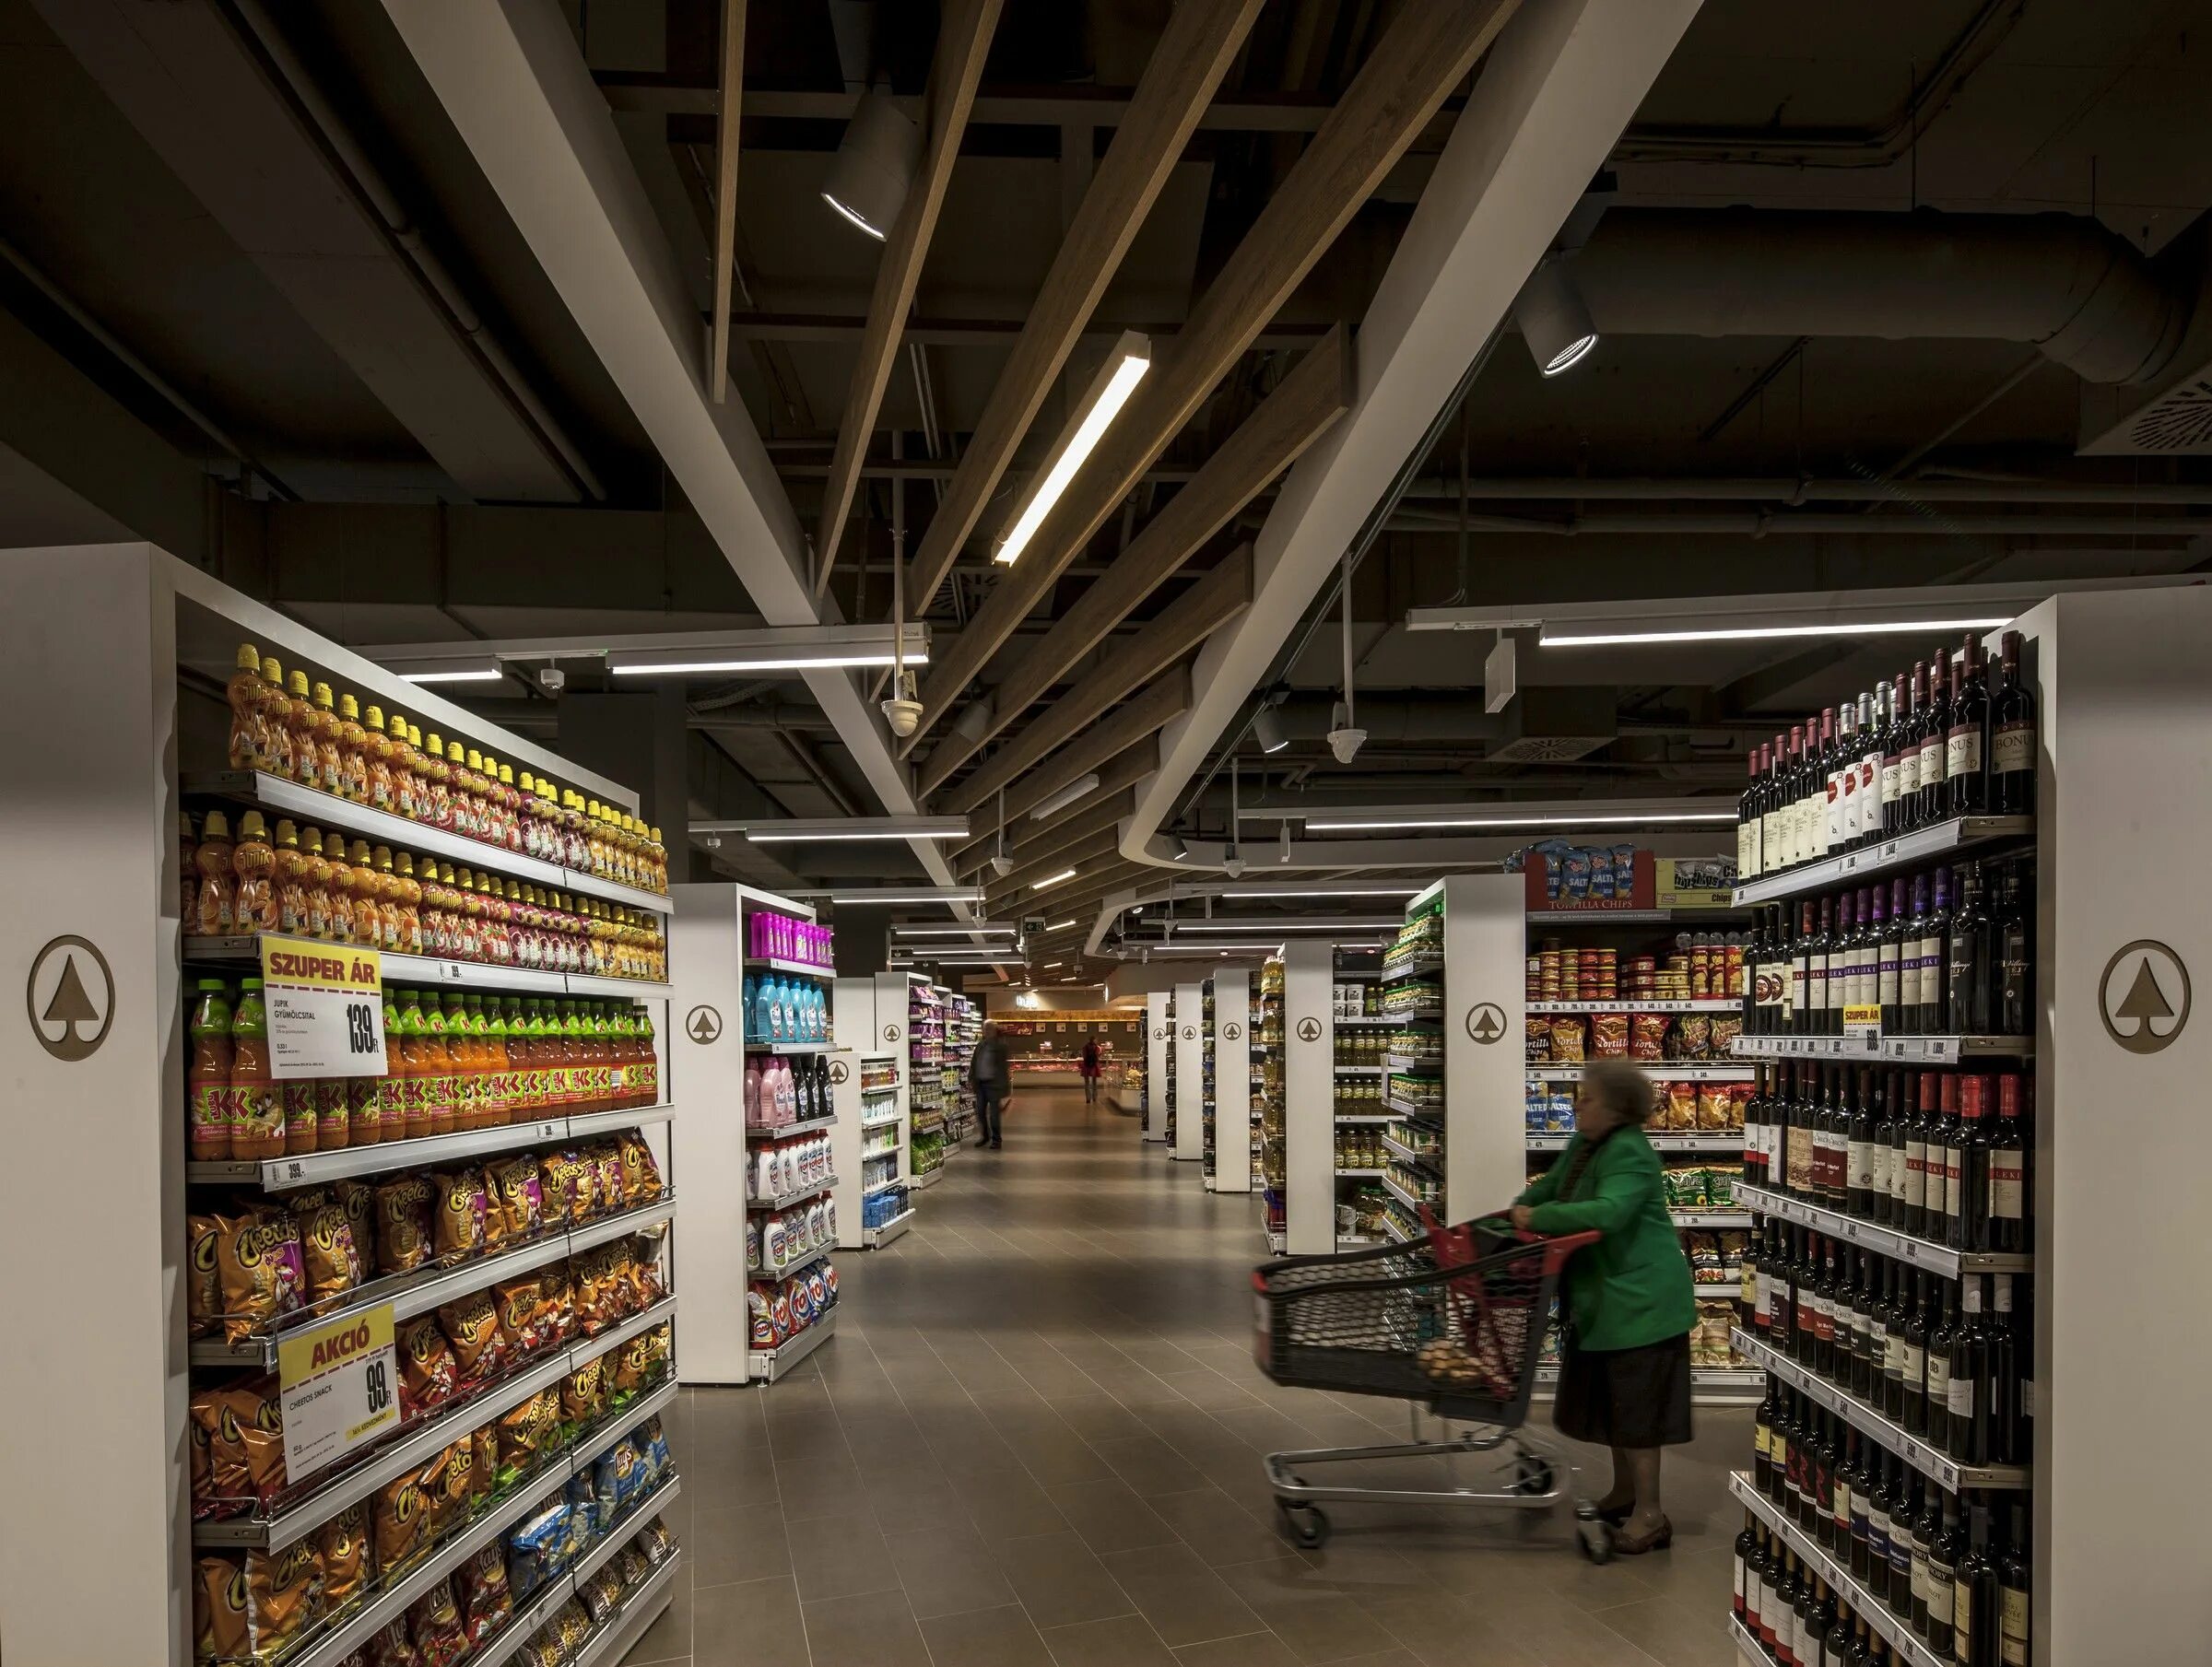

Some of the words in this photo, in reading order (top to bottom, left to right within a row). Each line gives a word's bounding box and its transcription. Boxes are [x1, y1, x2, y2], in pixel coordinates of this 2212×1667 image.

[1948, 738, 1973, 752] NUS
[1569, 877, 1588, 886] SALT
[1549, 900, 1598, 910] TOILLA
[1601, 899, 1632, 910] CHIPS
[1712, 893, 1732, 903] Chips
[269, 952, 346, 982] SZUPER
[350, 957, 375, 984] ÁR
[274, 999, 288, 1008] JUPIK
[1845, 1010, 1868, 1020] SZUPER
[1869, 1008, 1879, 1020] ÁR
[347, 1004, 374, 1054] 139
[1597, 1038, 1629, 1049] Tortill
[311, 1319, 371, 1370] AKCIÓ
[366, 1360, 386, 1414] 99
[288, 1394, 314, 1412] CHEETOS
[313, 1383, 333, 1401] SNACK
